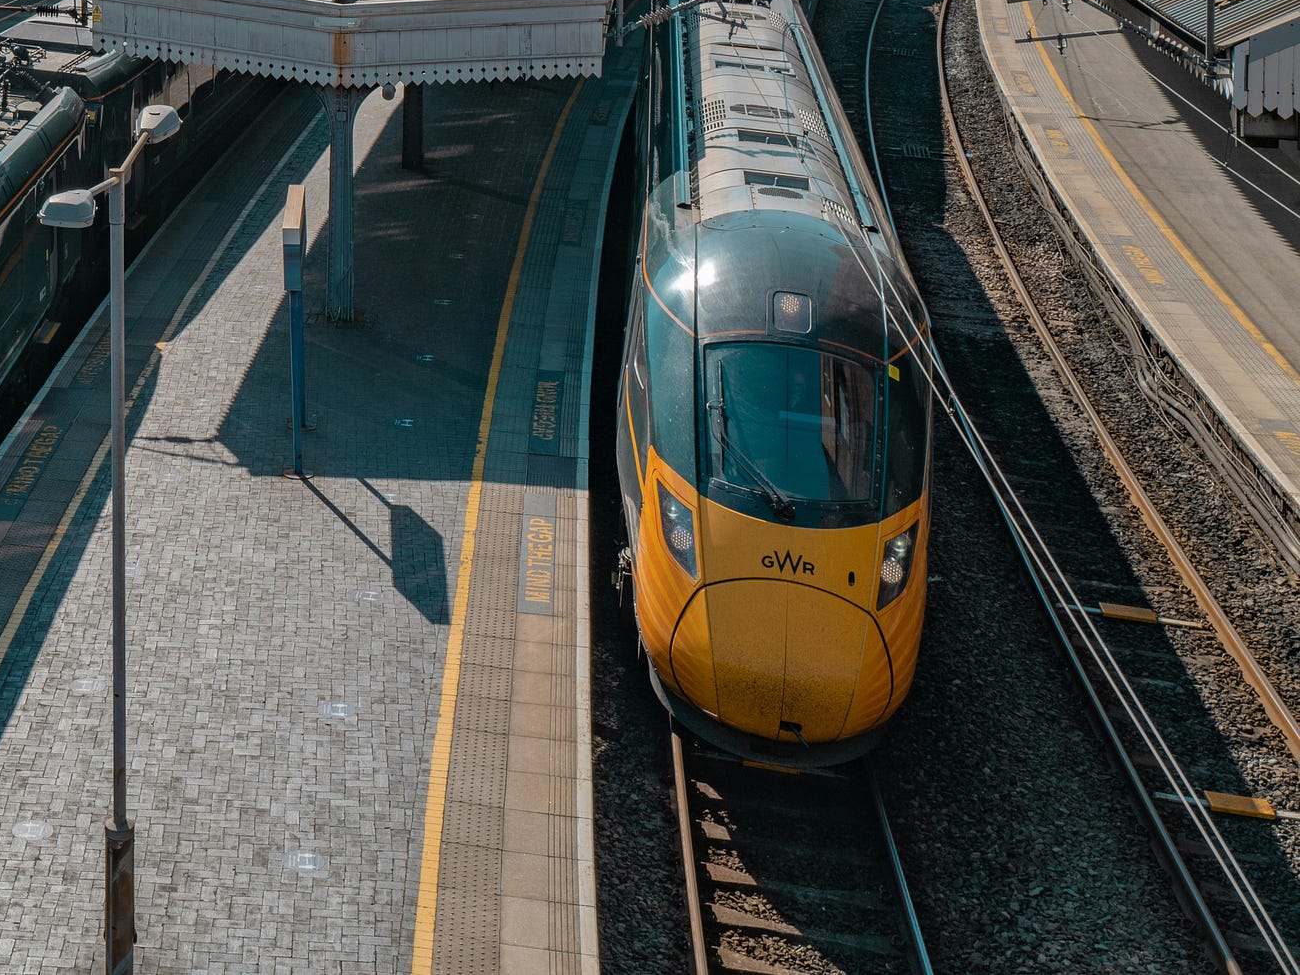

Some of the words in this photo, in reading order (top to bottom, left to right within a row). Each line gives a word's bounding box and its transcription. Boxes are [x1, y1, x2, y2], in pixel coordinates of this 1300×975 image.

[526, 518, 554, 543] GAP
[527, 543, 553, 567] THE
[761, 549, 815, 575] GWR
[524, 568, 551, 603] MIND
